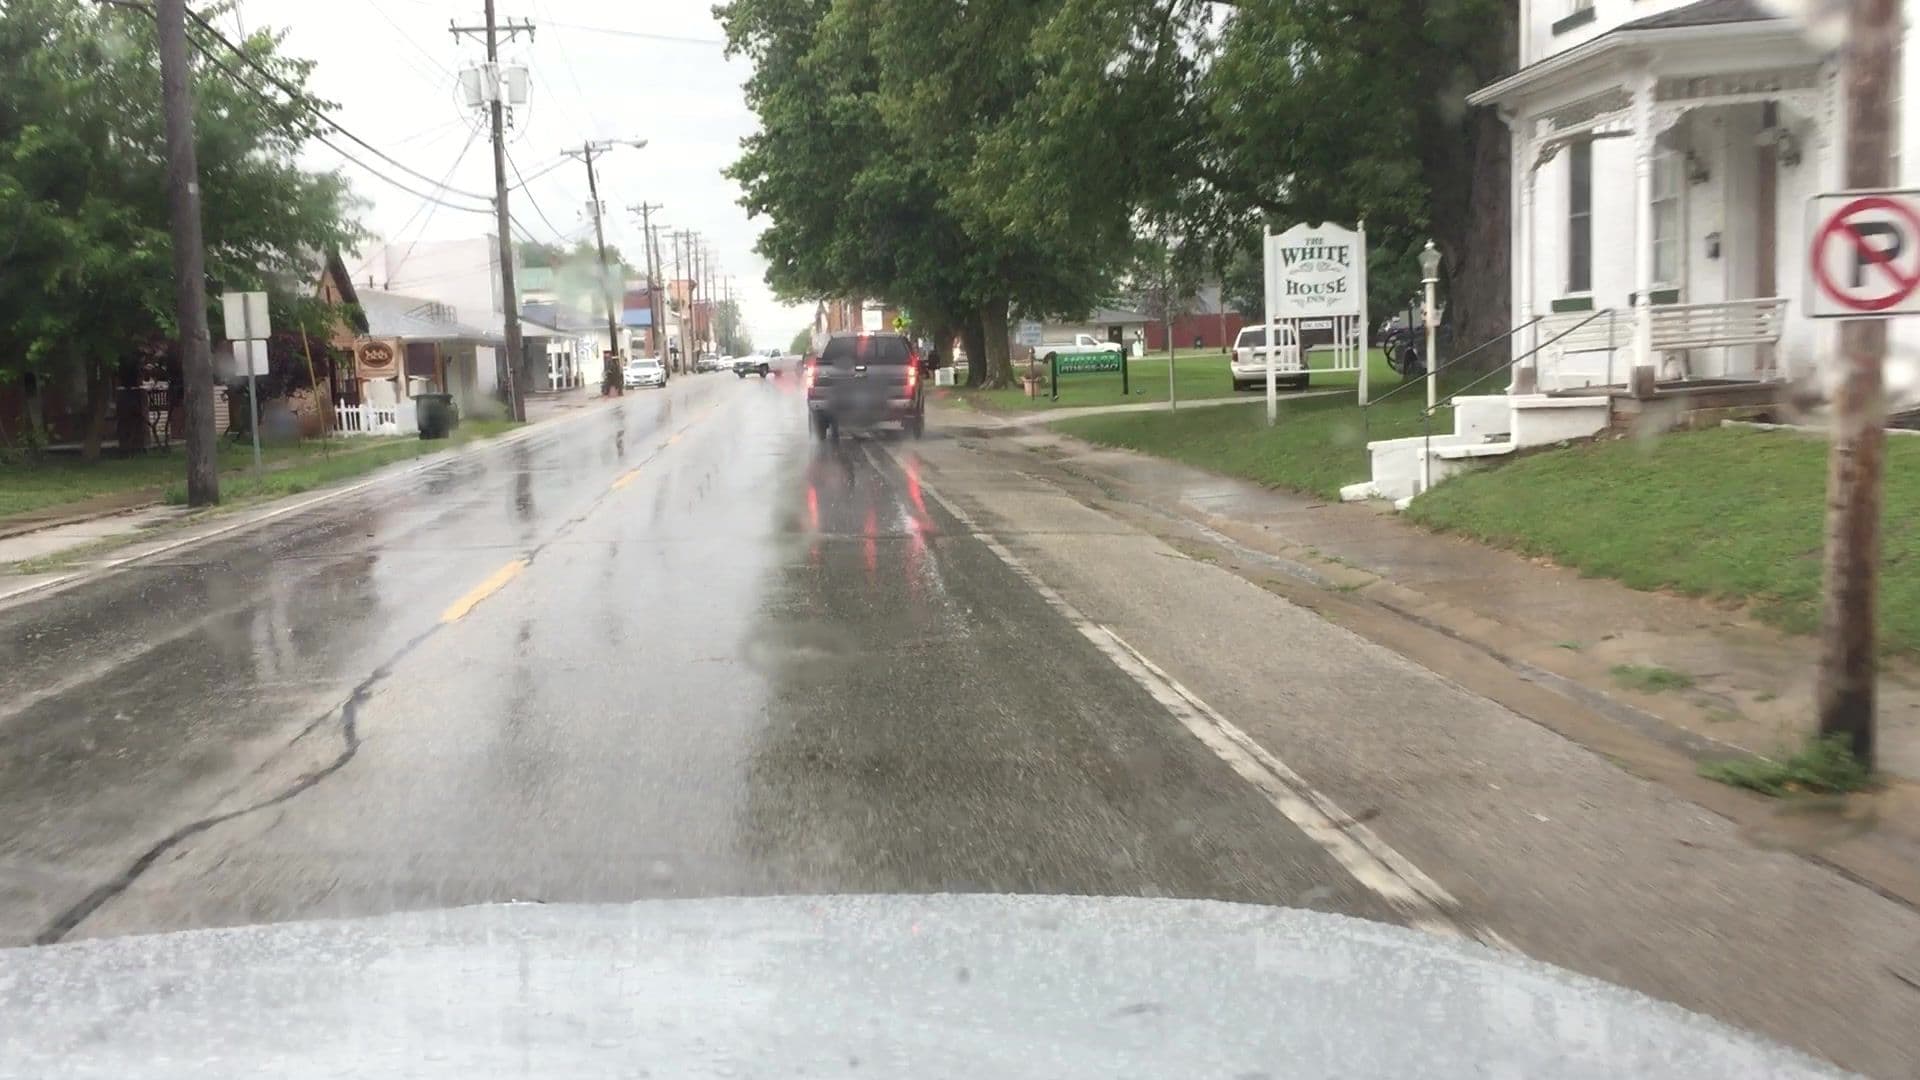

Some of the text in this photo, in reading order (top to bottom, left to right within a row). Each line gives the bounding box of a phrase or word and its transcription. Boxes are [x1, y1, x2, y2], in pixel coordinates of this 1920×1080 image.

[1304, 238, 1323, 246] THE
[1281, 245, 1350, 268] WHITE
[1846, 221, 1906, 288] P
[1286, 276, 1347, 296] HOUSE
